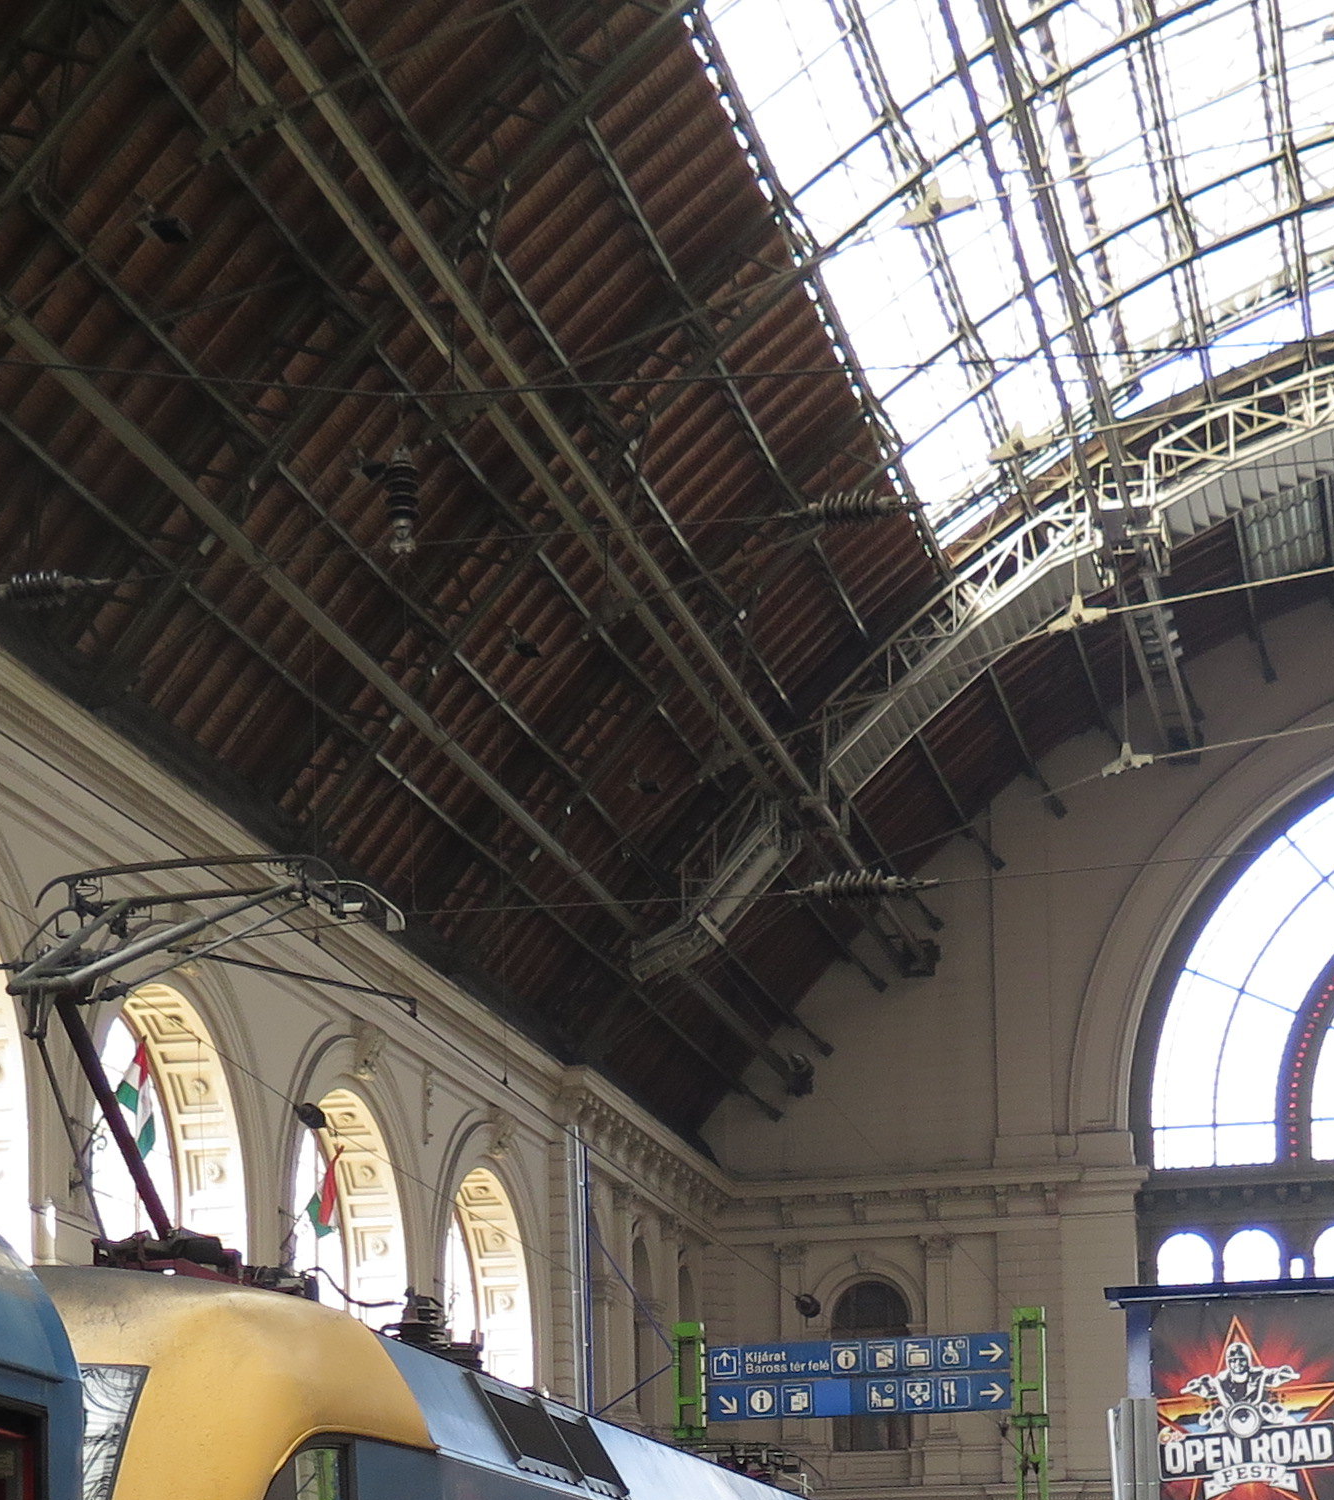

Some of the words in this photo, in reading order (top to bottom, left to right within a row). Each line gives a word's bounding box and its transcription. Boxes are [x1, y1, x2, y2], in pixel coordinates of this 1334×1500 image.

[745, 1351, 786, 1364] Kijárat
[745, 1363, 787, 1374] Baross
[790, 1361, 806, 1372] tér
[808, 1360, 830, 1371] felé
[1165, 1436, 1242, 1474] OPEN
[1250, 1428, 1333, 1464] ROAD
[1222, 1465, 1278, 1483] FEST
